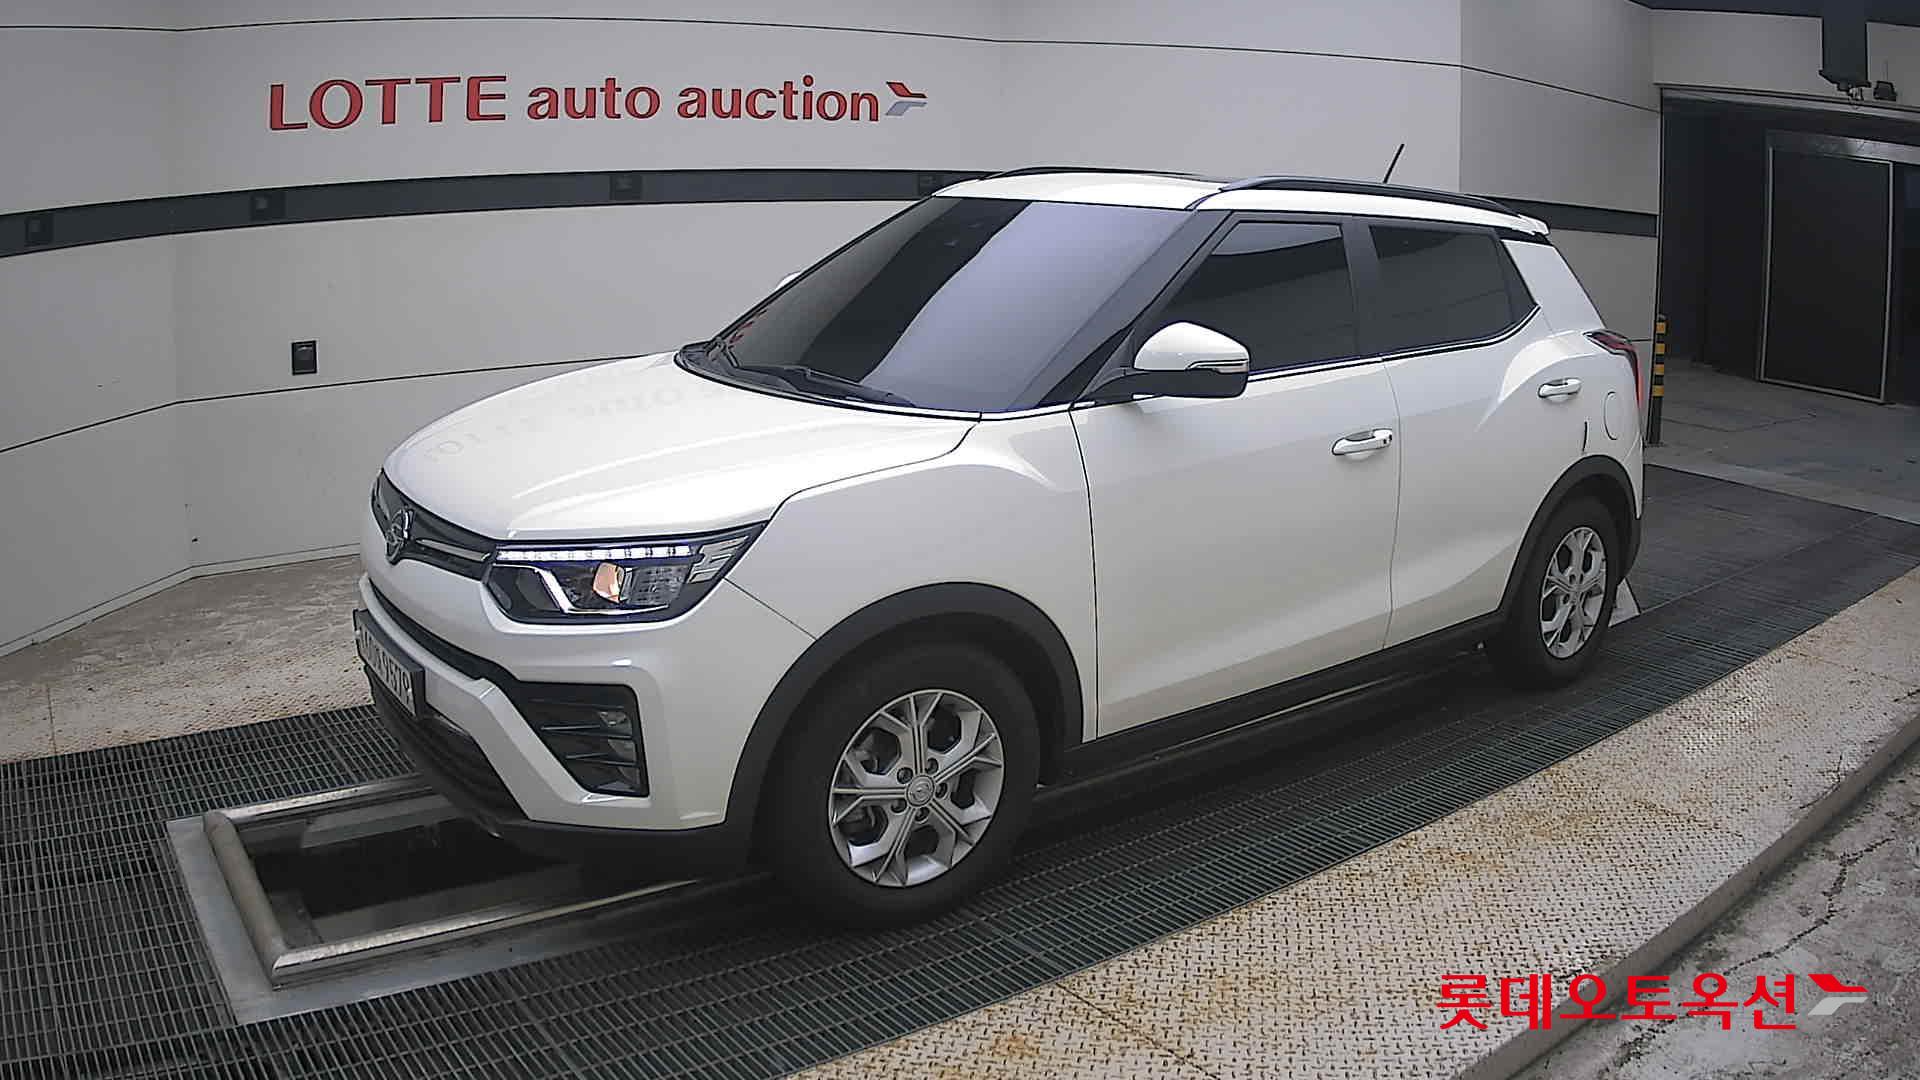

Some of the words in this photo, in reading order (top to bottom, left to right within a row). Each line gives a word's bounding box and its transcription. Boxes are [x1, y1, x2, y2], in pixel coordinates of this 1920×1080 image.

[269, 76, 506, 131] LOTTE
[526, 78, 661, 120] auto
[677, 75, 880, 121] auction
